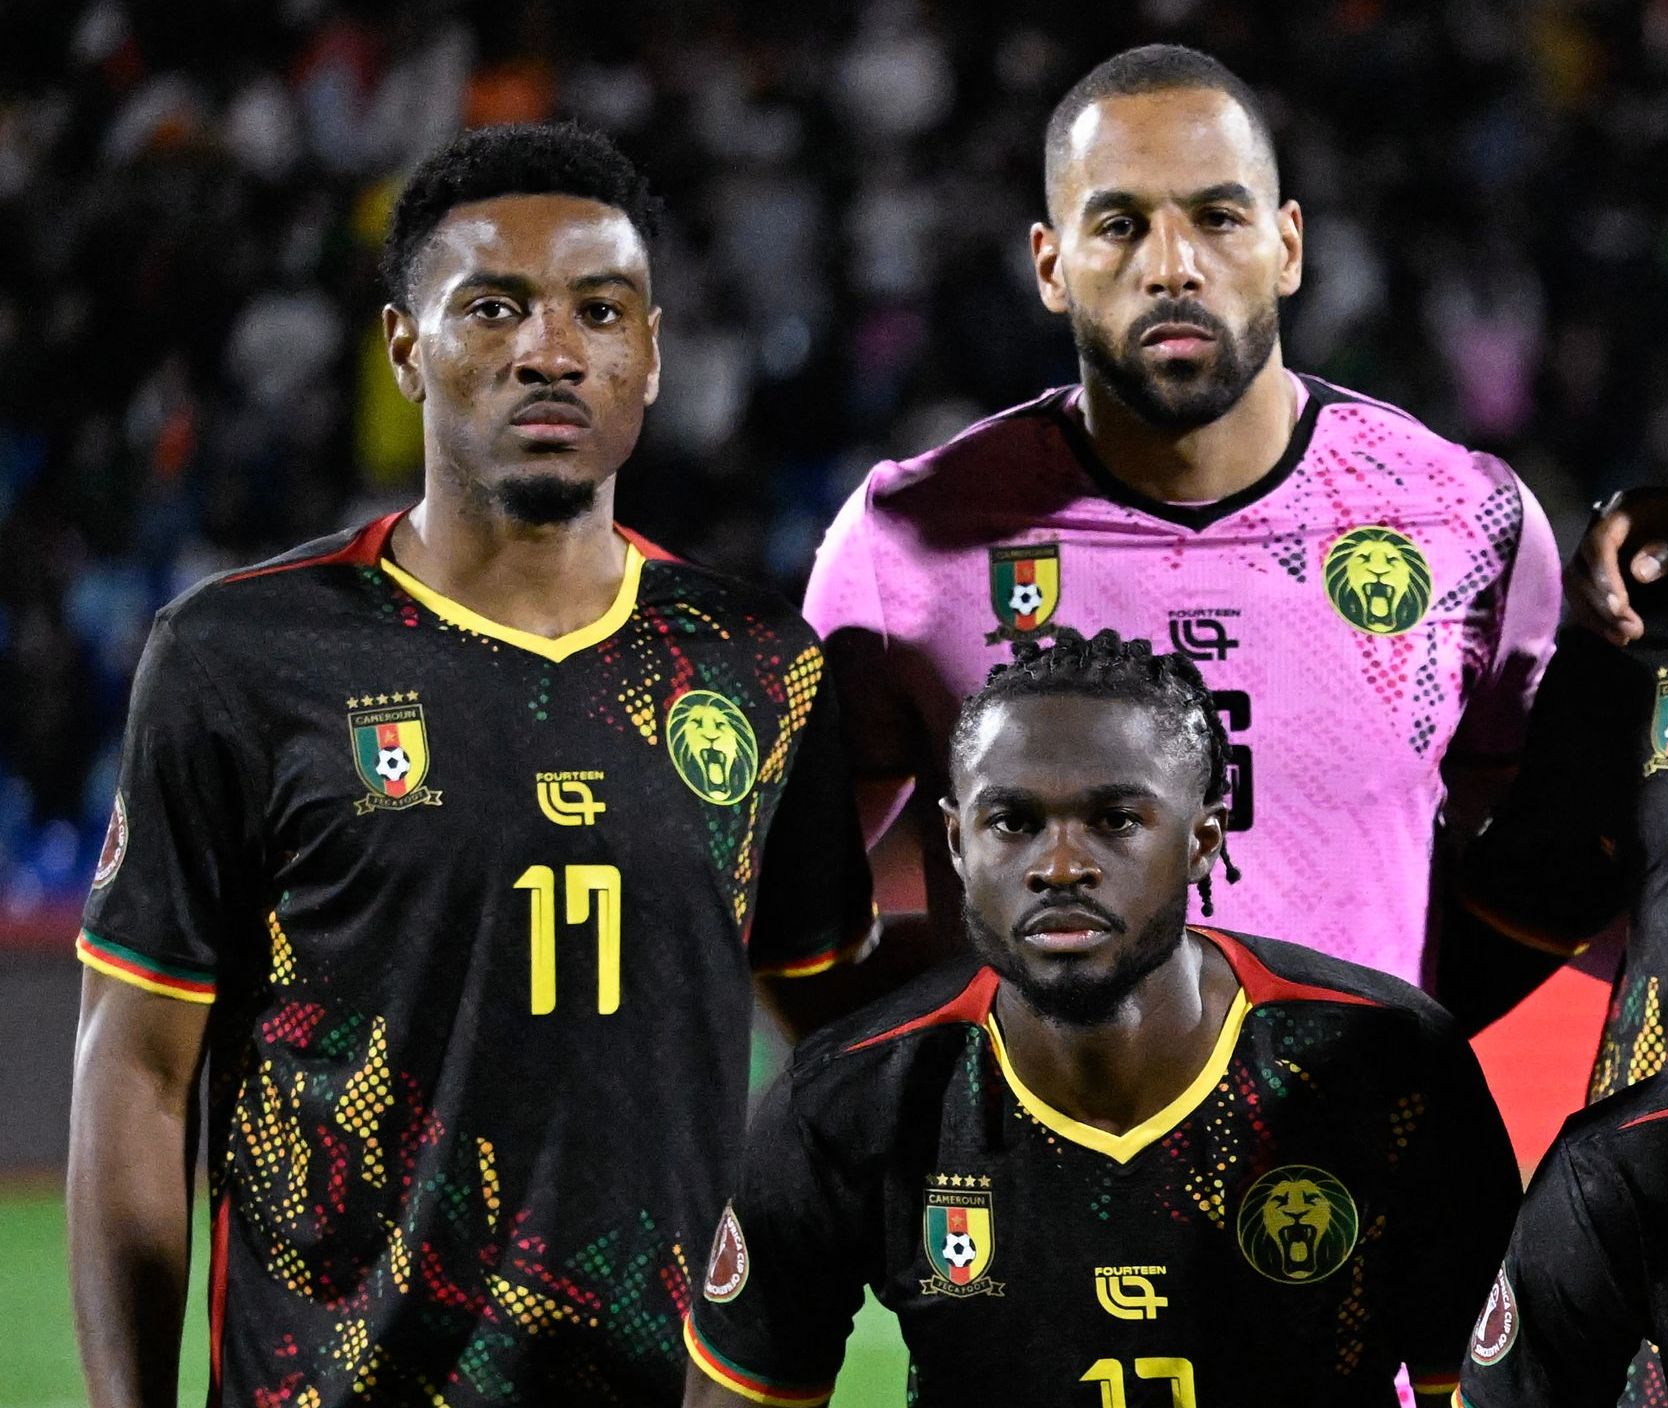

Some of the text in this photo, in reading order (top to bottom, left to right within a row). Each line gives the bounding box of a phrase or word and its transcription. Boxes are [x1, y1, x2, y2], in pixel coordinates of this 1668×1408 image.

[1168, 609, 1242, 619] FOURTEEN
[355, 711, 417, 726] CAMEROUN
[536, 771, 605, 782] FOURTEEN
[513, 866, 622, 1016] 17
[929, 1194, 987, 1207] CAMEROUN
[1094, 1265, 1168, 1277] FOURTEEN
[1503, 1311, 1513, 1335] CUP
